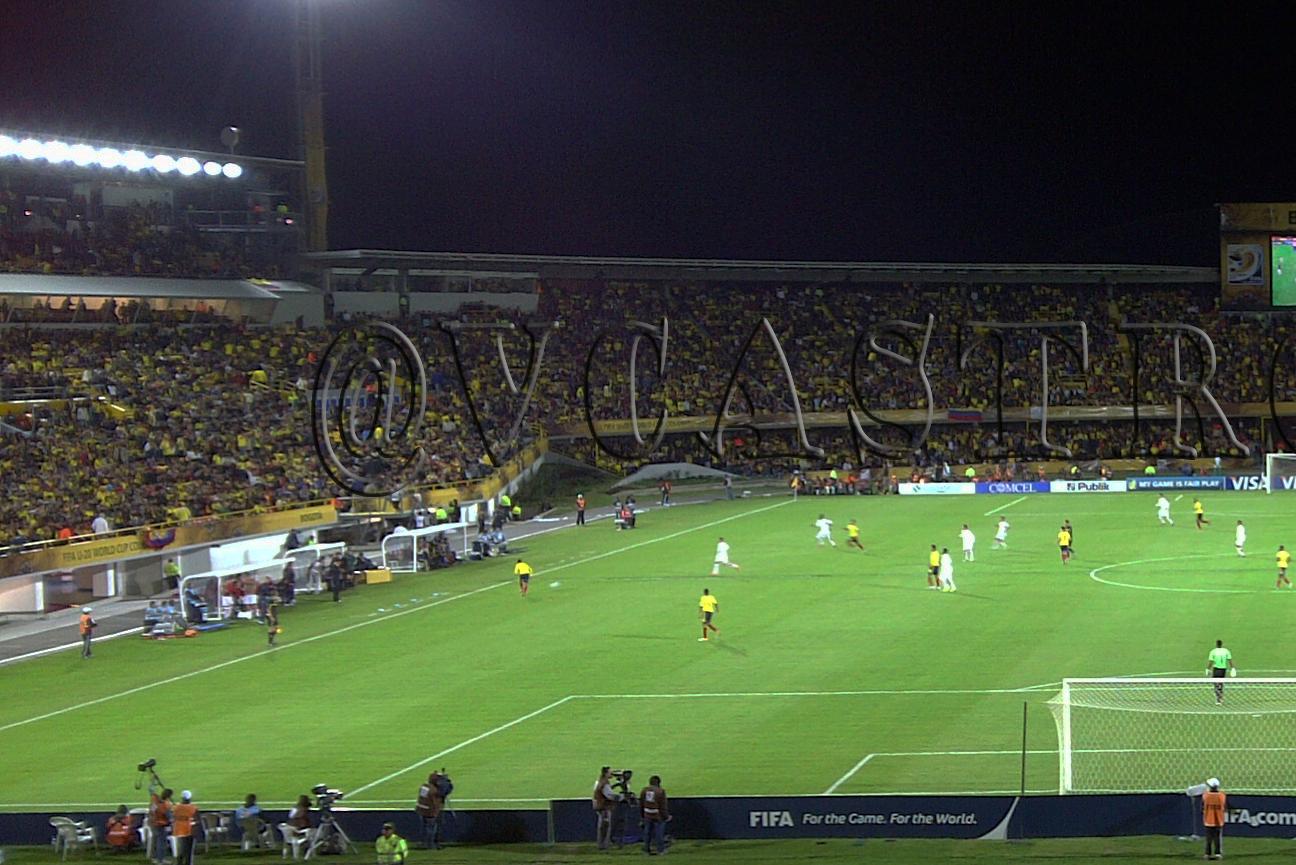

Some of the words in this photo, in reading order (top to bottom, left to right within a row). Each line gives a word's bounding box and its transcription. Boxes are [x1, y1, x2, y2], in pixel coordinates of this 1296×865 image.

[988, 482, 1036, 493] COMCEL
[1232, 475, 1267, 490] VISA
[749, 811, 795, 828] FIFA
[802, 813, 823, 825] For
[824, 813, 846, 825] the
[848, 812, 887, 825] Game.
[890, 813, 911, 825] For
[912, 813, 934, 825] the
[936, 812, 978, 825] World.
